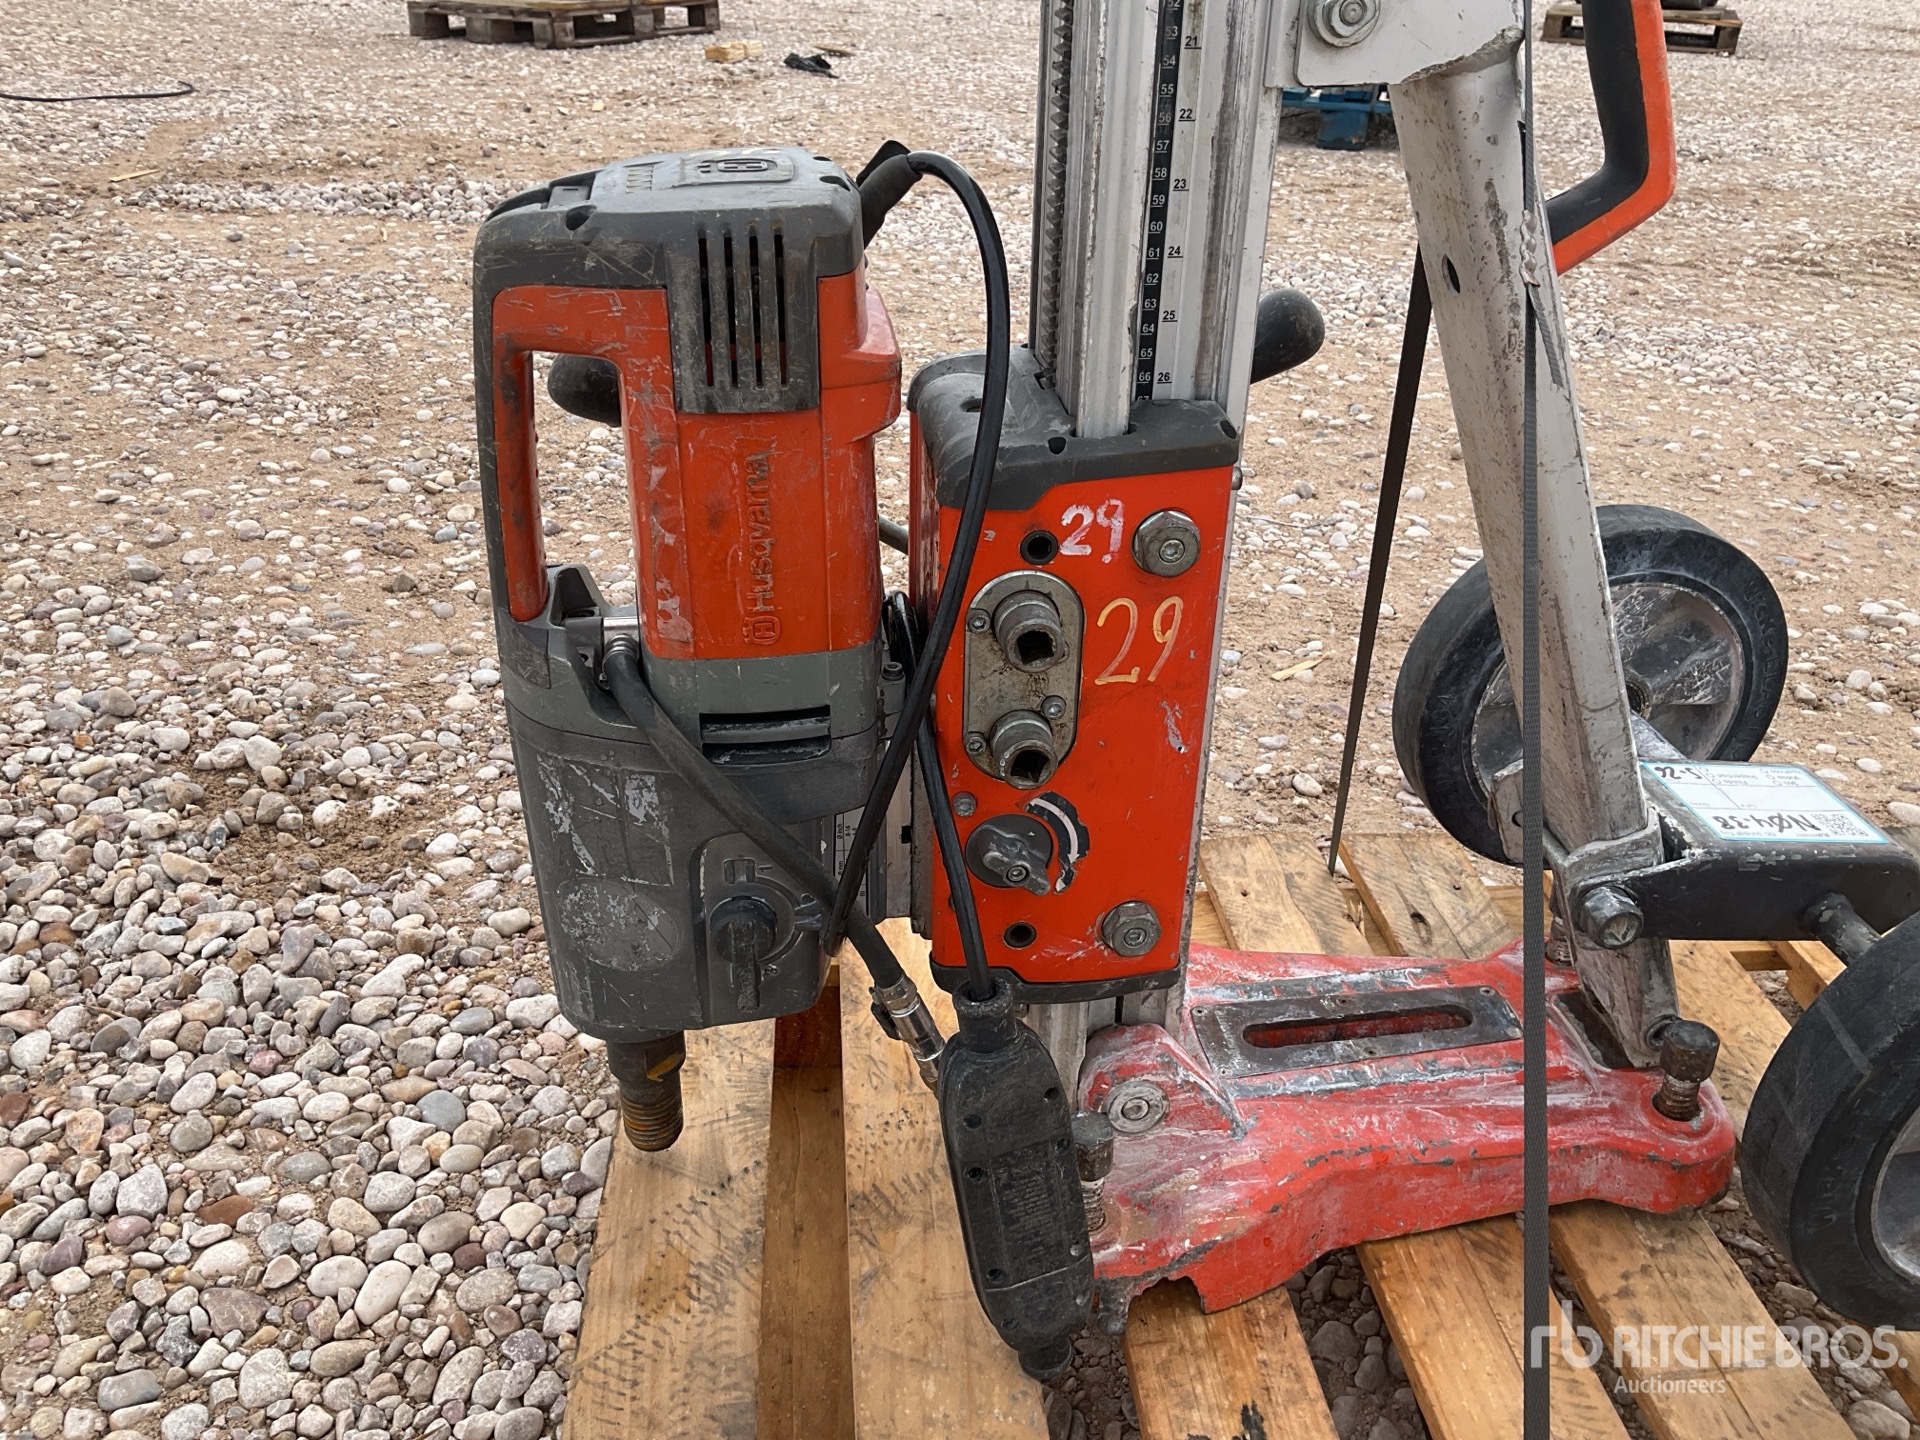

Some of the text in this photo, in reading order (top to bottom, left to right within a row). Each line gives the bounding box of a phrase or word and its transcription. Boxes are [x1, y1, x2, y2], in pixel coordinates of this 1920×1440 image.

[1166, 26, 1178, 37] 53
[1185, 36, 1198, 47] 21
[1163, 55, 1176, 66] 54
[1160, 84, 1174, 94] 55
[1158, 112, 1172, 123] 56
[1179, 109, 1192, 119] 22
[1156, 140, 1169, 150] 57
[1154, 167, 1167, 178] 58
[1174, 179, 1186, 189] 23
[1152, 195, 1165, 205] 59
[1150, 221, 1163, 231] 60
[1148, 248, 1160, 257] 61
[1168, 246, 1181, 256] 24
[1146, 273, 1159, 283] 62
[1144, 299, 1157, 308] 63
[1163, 311, 1175, 320] 25
[1142, 324, 1155, 333] 64
[1140, 348, 1153, 358] 65
[1138, 372, 1151, 381] 66
[1158, 372, 1170, 381] 26
[744, 451, 777, 612] Husqvarna
[1060, 498, 1124, 564] 29
[1094, 595, 1184, 686] 29
